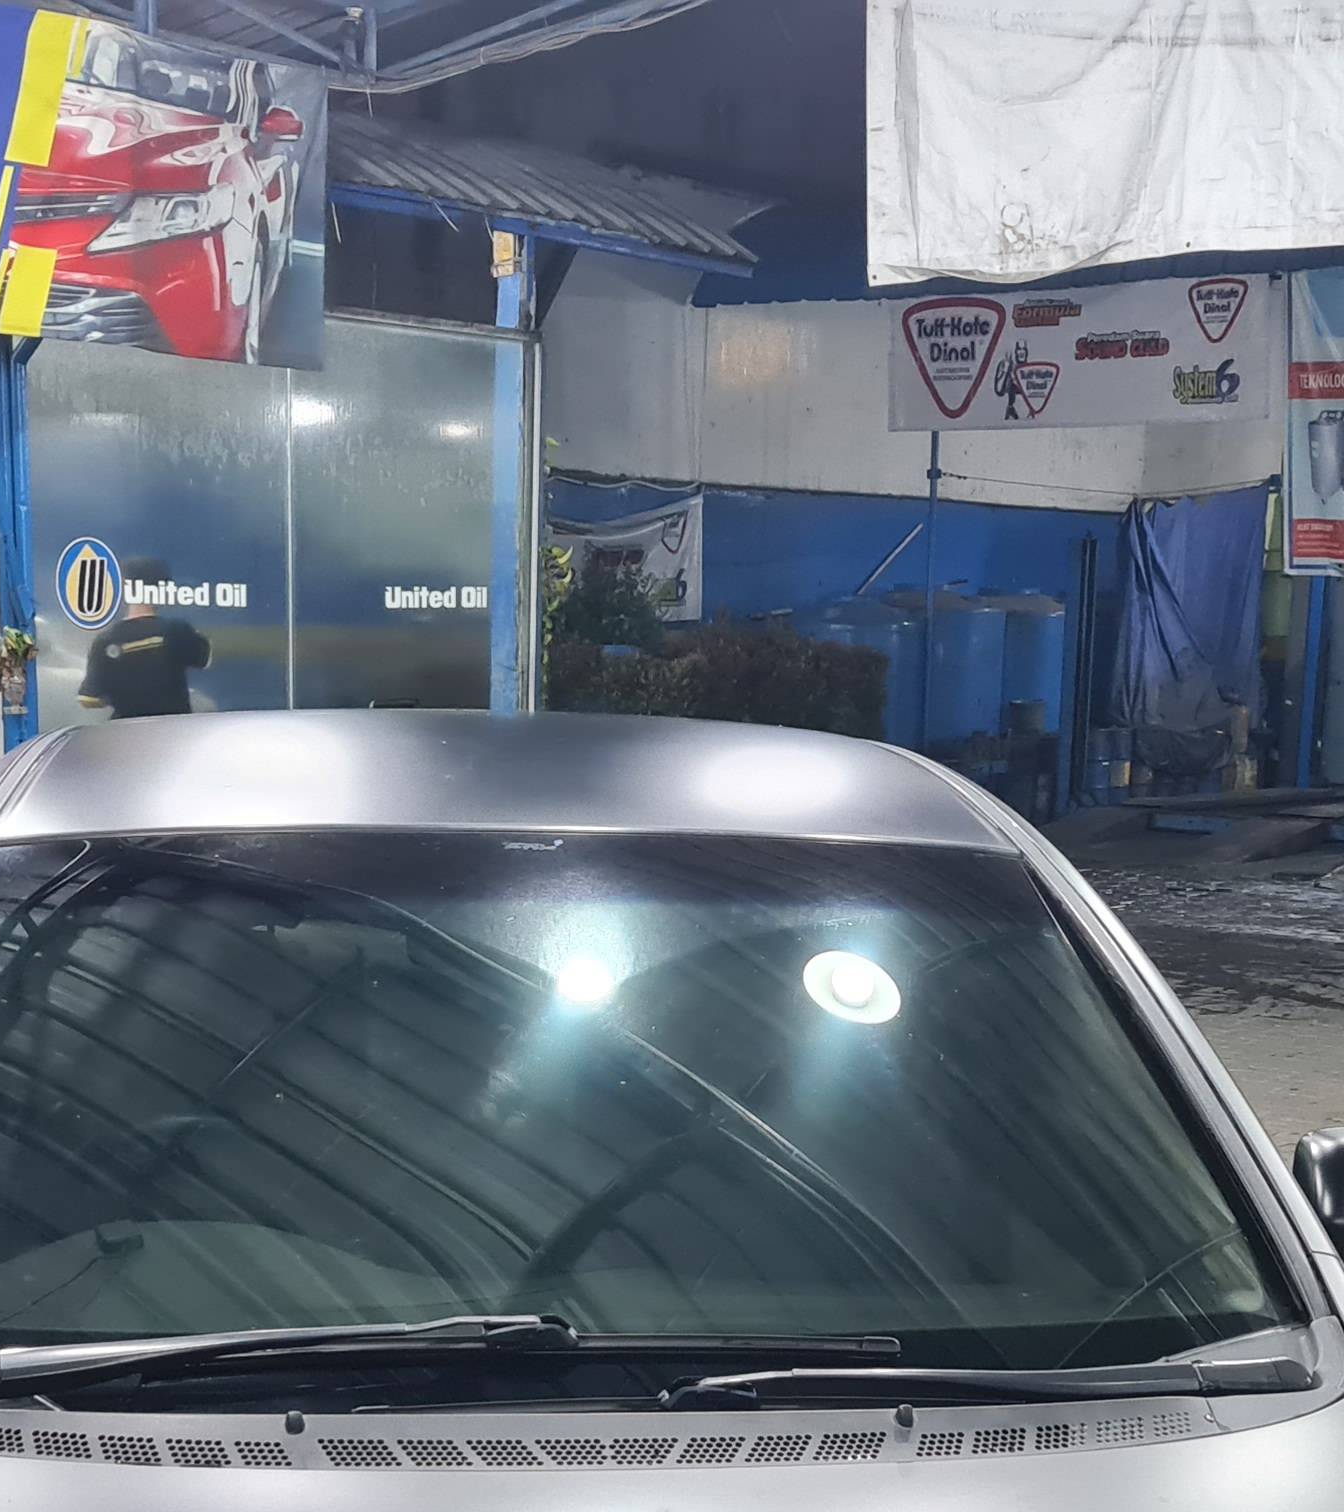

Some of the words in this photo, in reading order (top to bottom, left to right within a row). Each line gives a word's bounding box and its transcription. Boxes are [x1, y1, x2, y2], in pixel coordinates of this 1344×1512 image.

[930, 341, 976, 364] Dinol
[123, 578, 210, 608] United
[215, 583, 248, 609] Oil
[384, 585, 457, 609] United
[460, 586, 489, 609] Oil
